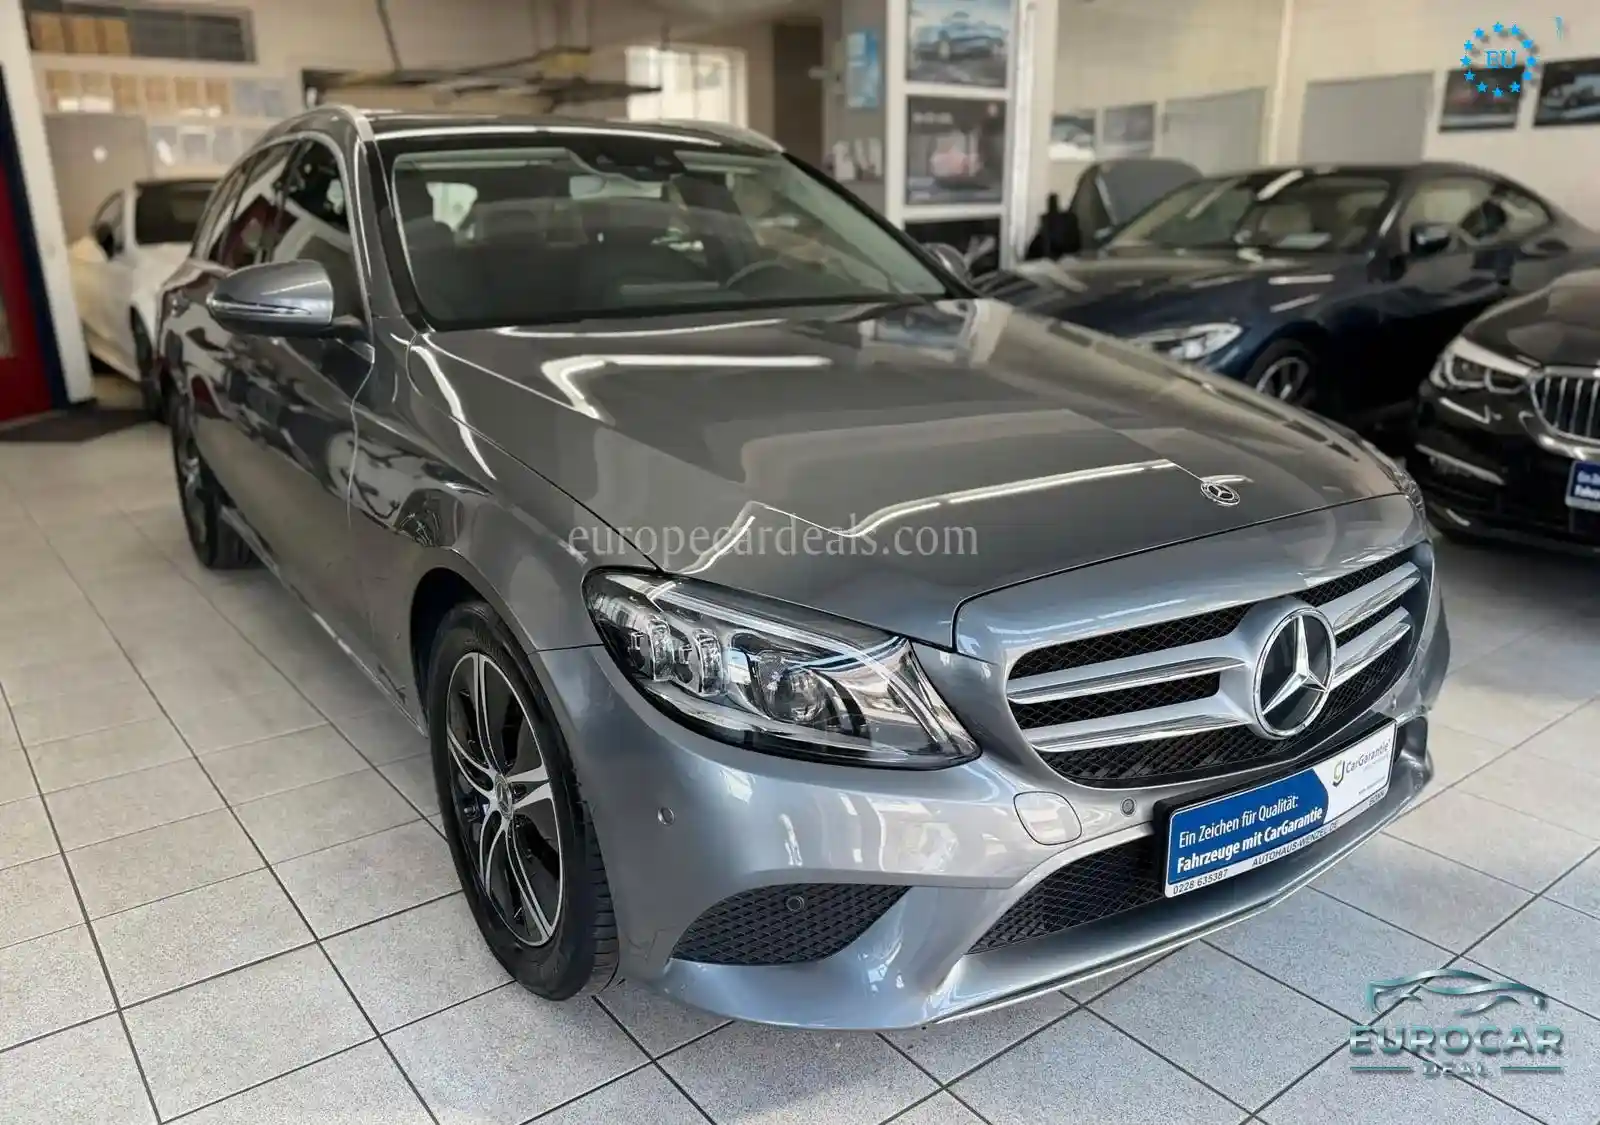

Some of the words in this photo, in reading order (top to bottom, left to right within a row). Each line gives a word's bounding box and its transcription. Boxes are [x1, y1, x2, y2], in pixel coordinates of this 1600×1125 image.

[1177, 842, 1240, 873] Fahrzeuge
[1242, 831, 1262, 852] mit
[1264, 806, 1323, 842] CarGarantie
[1179, 831, 1196, 848] Ein
[1198, 817, 1239, 842] Zeichen
[1241, 810, 1257, 828] für
[1173, 881, 1195, 895] 0228
[1197, 868, 1228, 887] 635387
